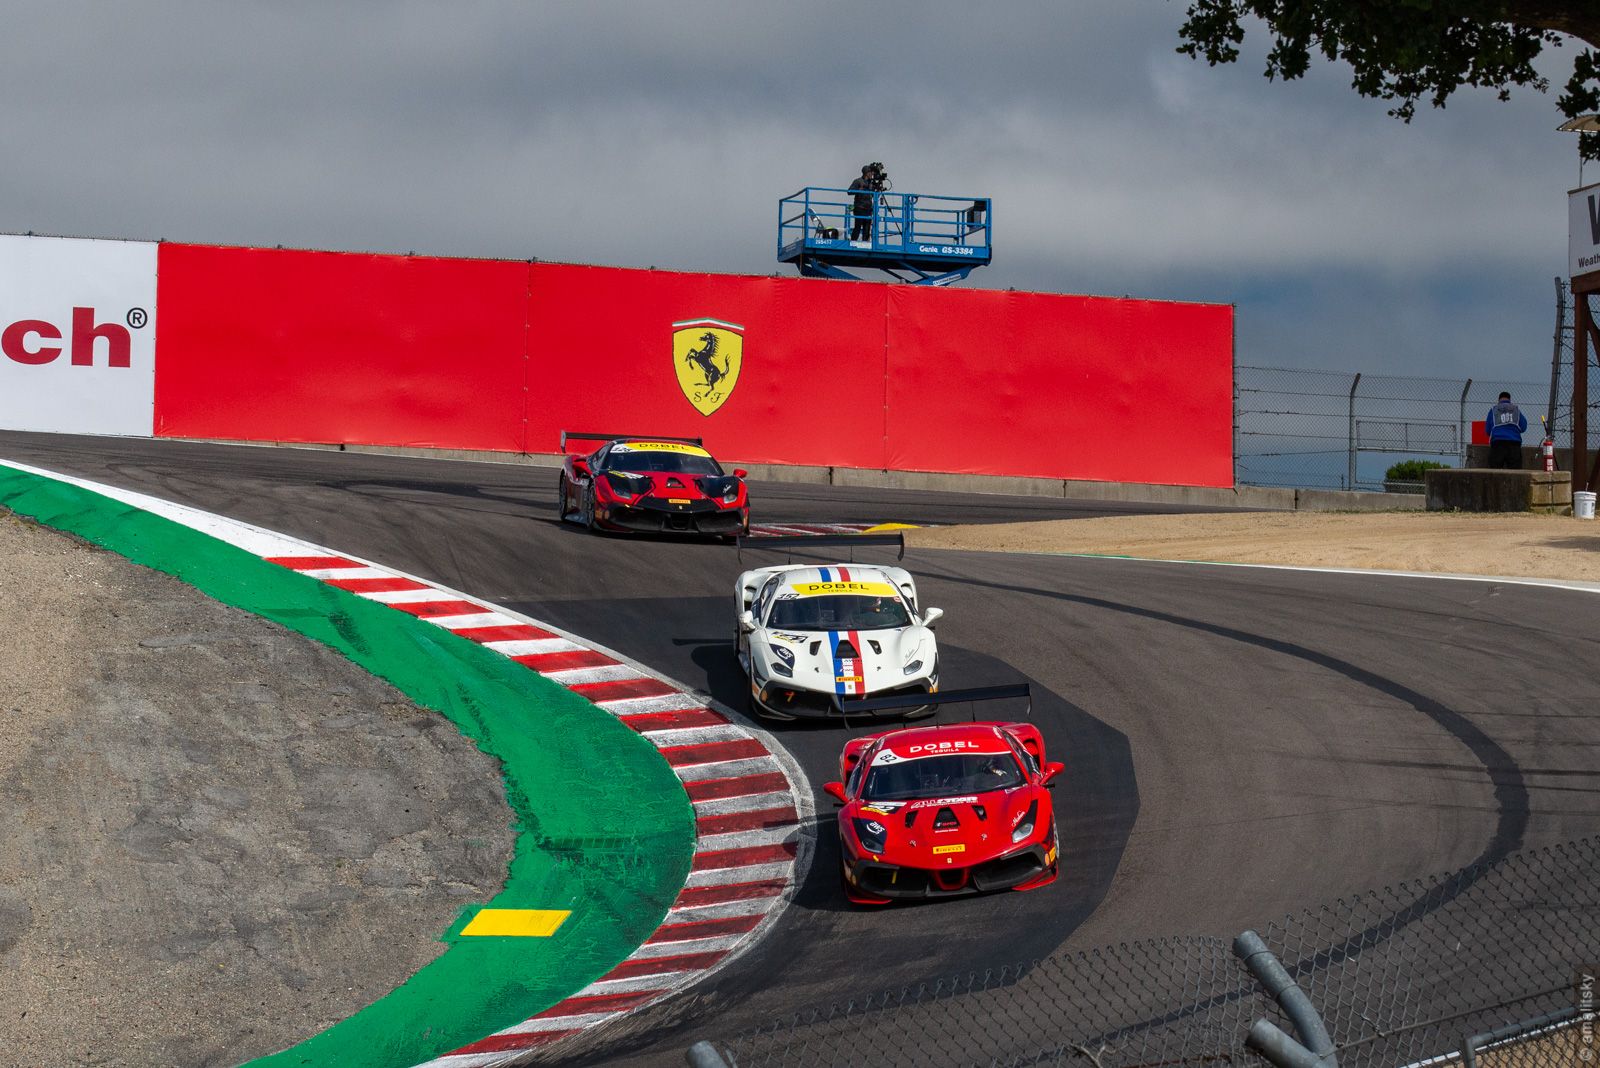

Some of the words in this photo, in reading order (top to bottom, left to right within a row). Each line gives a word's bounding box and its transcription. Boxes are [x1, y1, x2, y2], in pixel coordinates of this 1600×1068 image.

[919, 245, 938, 253] Genie
[809, 583, 870, 591] DOBEL
[909, 741, 980, 754] DOBEL
[869, 821, 885, 833] aws
